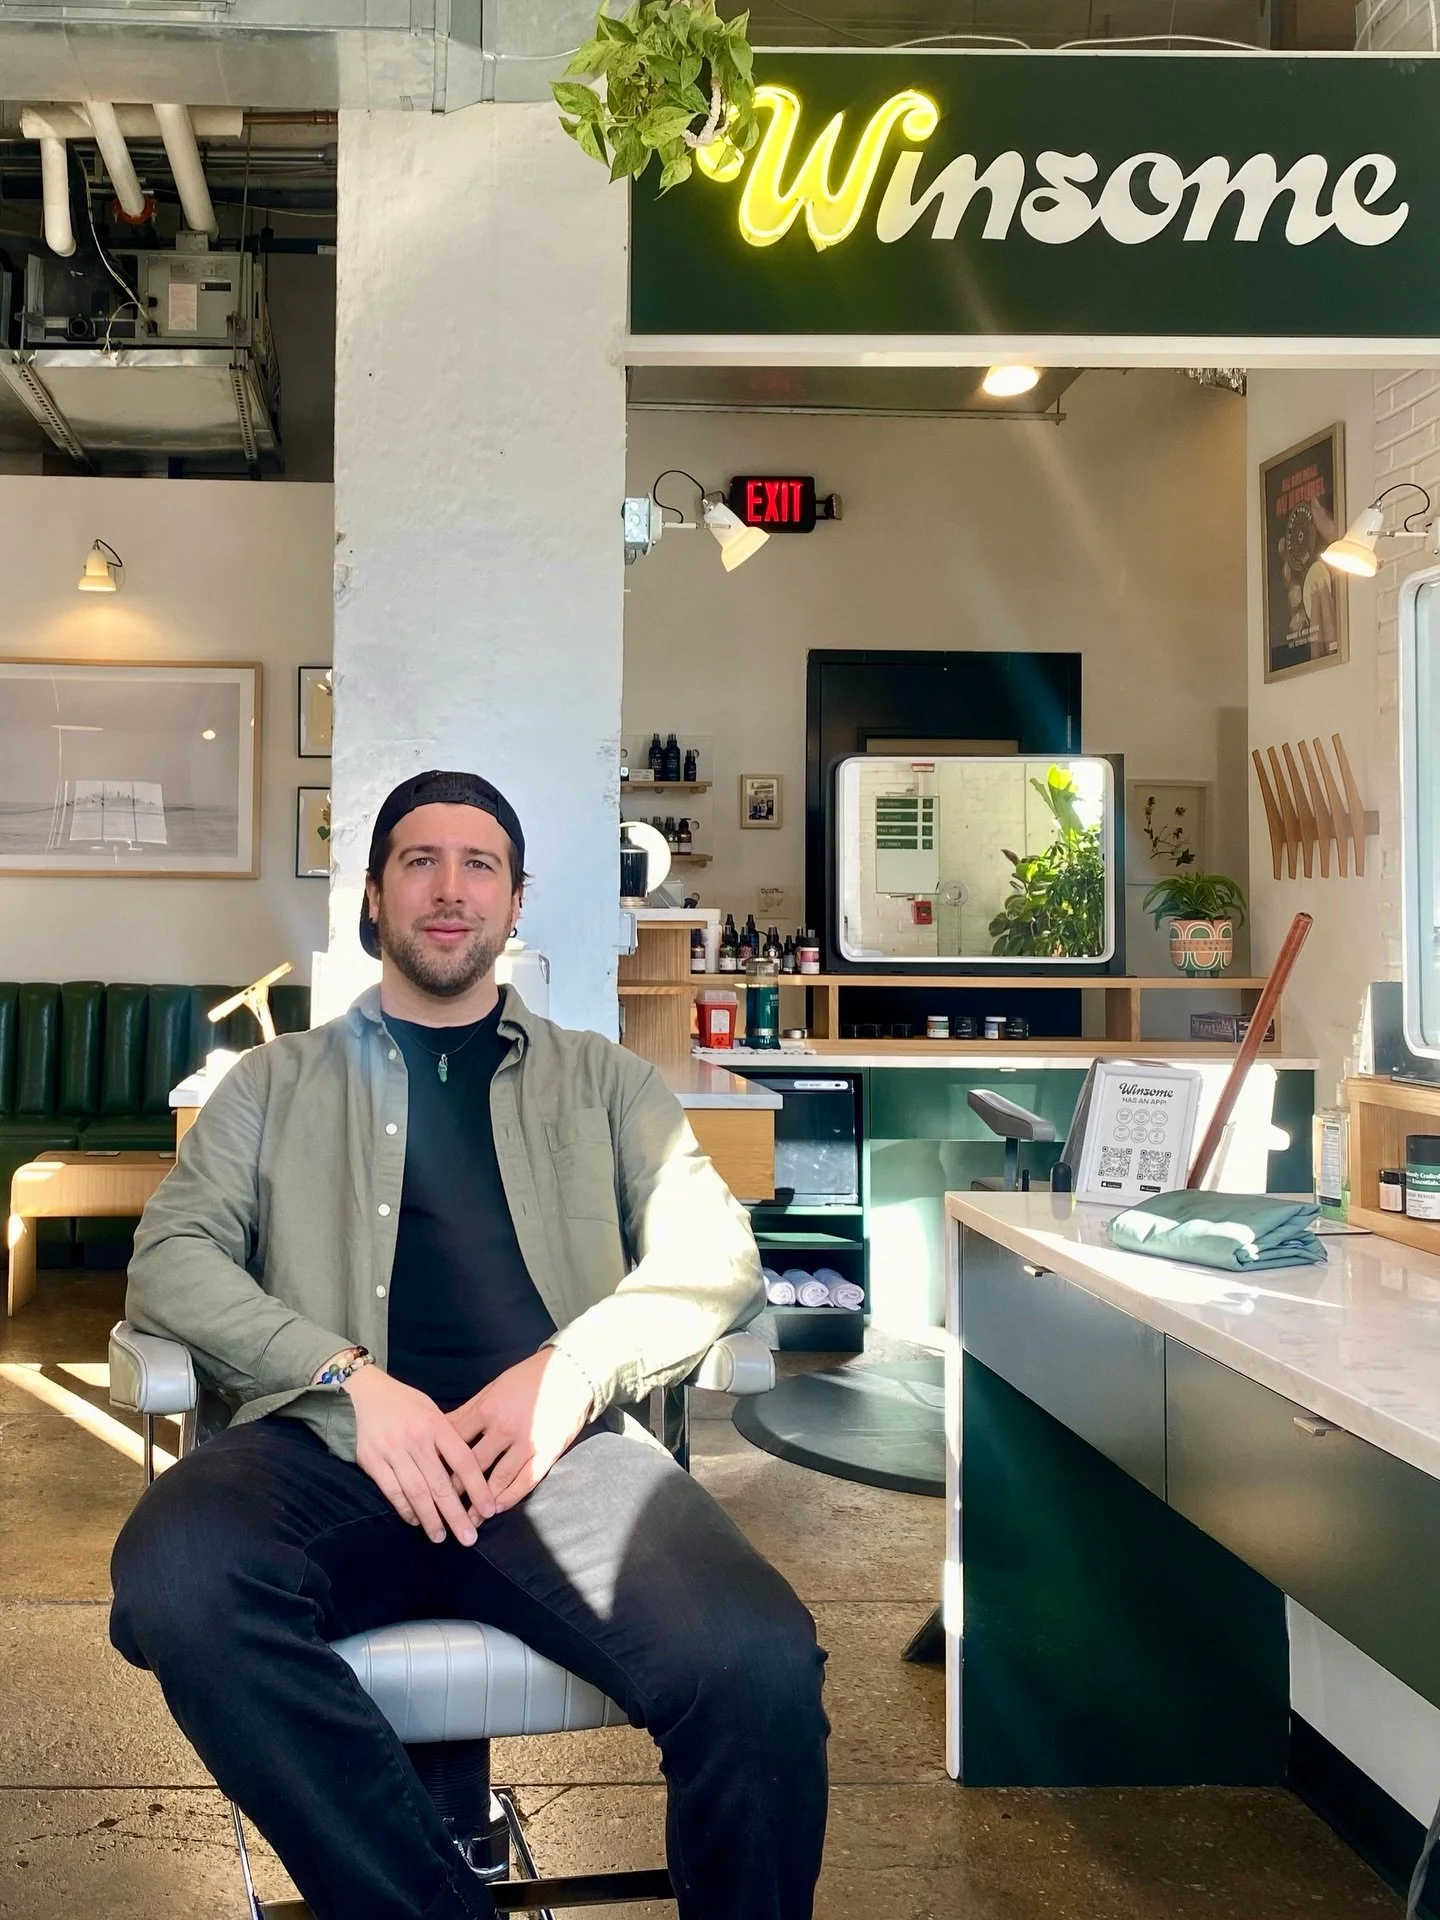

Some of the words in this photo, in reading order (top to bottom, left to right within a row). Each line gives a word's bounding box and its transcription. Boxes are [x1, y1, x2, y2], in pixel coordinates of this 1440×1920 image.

[696, 84, 1409, 252] Winsome
[747, 481, 804, 522] EXIT
[1119, 1082, 1173, 1097] Winsome
